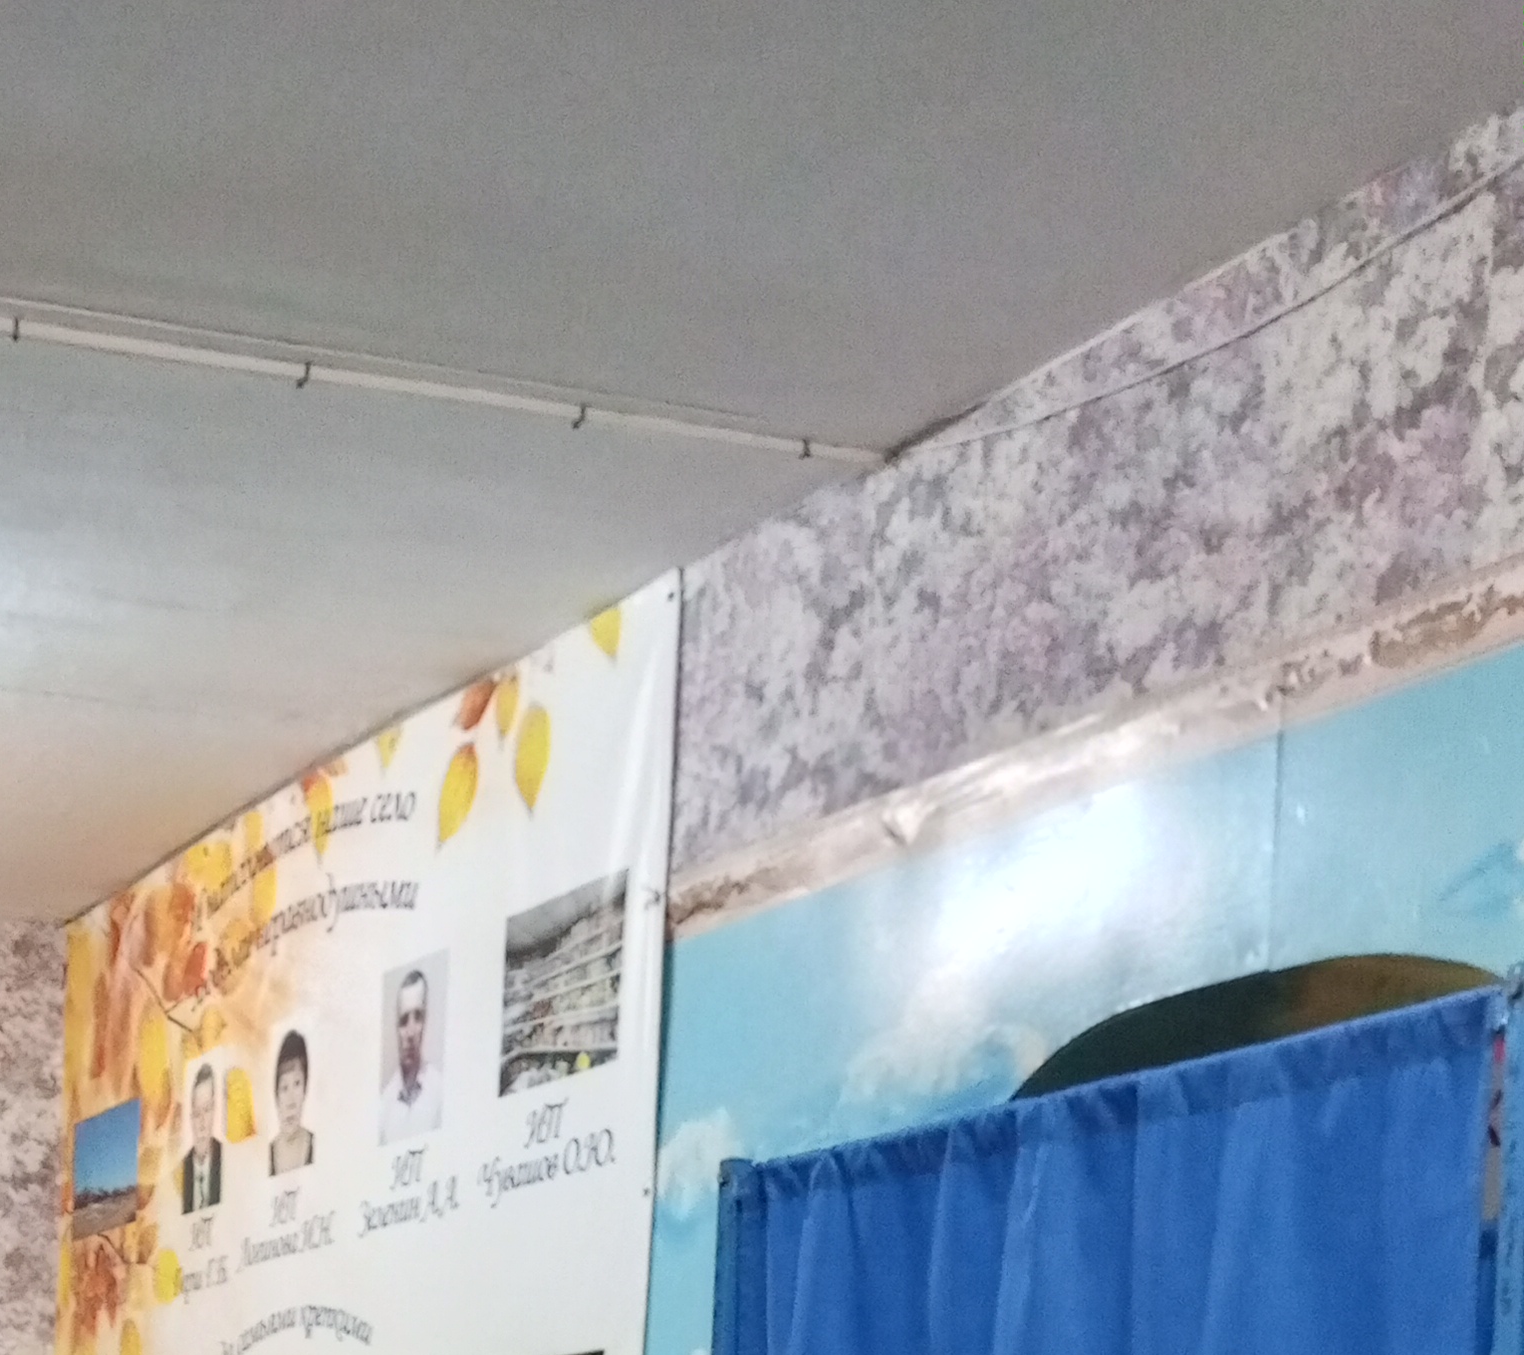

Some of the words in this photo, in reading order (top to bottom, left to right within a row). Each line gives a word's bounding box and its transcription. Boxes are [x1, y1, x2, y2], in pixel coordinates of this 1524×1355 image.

[370, 791, 416, 824] село
[523, 1097, 570, 1148] ИП
[389, 1144, 429, 1190] ИП
